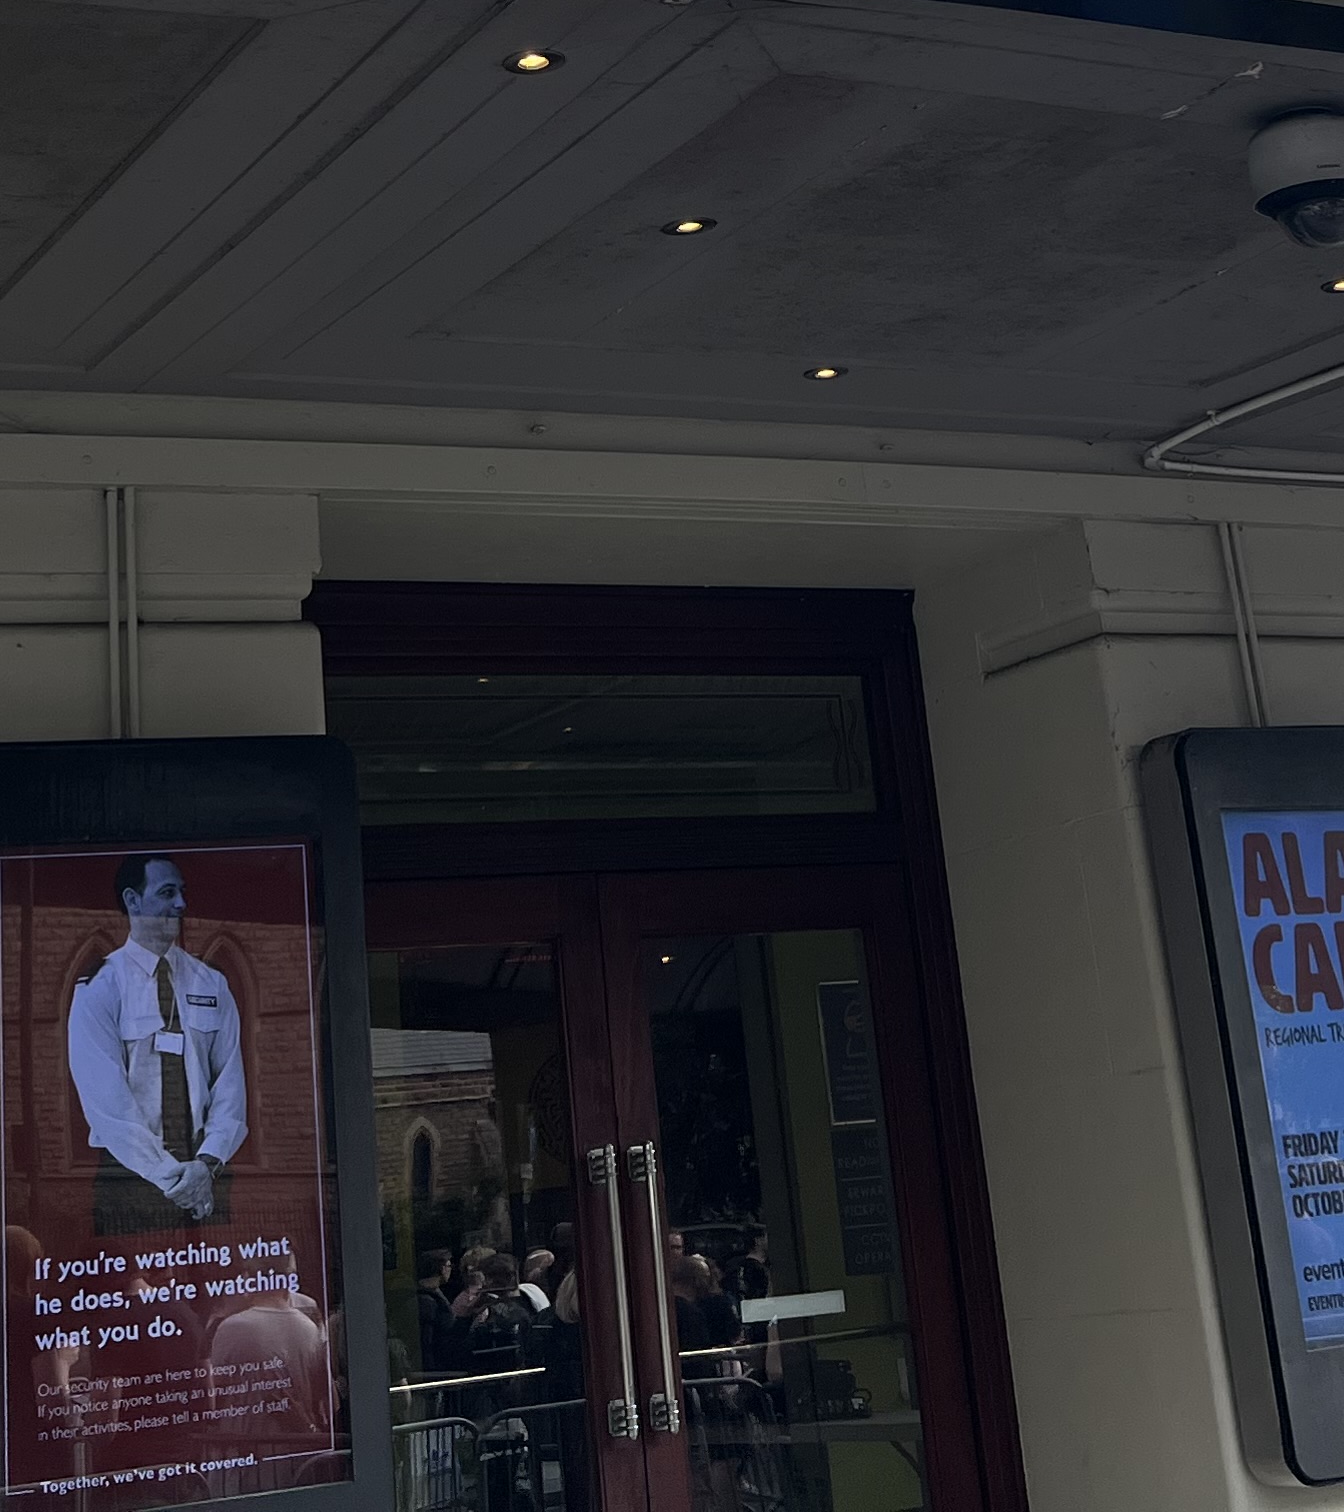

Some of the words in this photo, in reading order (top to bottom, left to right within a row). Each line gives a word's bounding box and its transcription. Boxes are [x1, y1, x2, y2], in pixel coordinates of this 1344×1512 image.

[1264, 1025, 1327, 1047] REGIONAL
[1282, 1131, 1338, 1158] FRIDAY
[35, 1258, 51, 1280] If
[58, 1251, 127, 1283] you're
[135, 1242, 232, 1270] watching
[238, 1237, 290, 1260] what
[35, 1293, 62, 1316] he
[70, 1288, 131, 1310] does,
[138, 1279, 197, 1305] we're
[205, 1269, 300, 1298] watching
[35, 1327, 91, 1351] what
[97, 1324, 139, 1349] you
[147, 1316, 183, 1337] do.
[37, 1383, 61, 1397] Our
[66, 1377, 110, 1394] security
[112, 1377, 141, 1388] team
[144, 1373, 162, 1384] are
[165, 1369, 191, 1381] here
[194, 1367, 207, 1378] to
[209, 1364, 236, 1378] keep
[239, 1361, 260, 1376] you
[37, 1405, 47, 1418] If
[48, 1406, 70, 1421] you
[73, 1398, 109, 1414] notice
[111, 1395, 153, 1411] anyone
[155, 1388, 188, 1404] taking
[191, 1387, 205, 1399] an
[207, 1381, 249, 1397] unusual
[251, 1376, 293, 1392] interest
[51, 1425, 78, 1439] their
[134, 1414, 169, 1432] please
[172, 1410, 190, 1425] tell
[192, 1411, 200, 1422] a
[202, 1404, 250, 1420] member
[252, 1399, 265, 1414] of
[40, 1474, 110, 1495] Together,
[113, 1469, 155, 1484] we've
[158, 1463, 182, 1482] got
[185, 1460, 197, 1473] it
[200, 1452, 259, 1472] covered.
